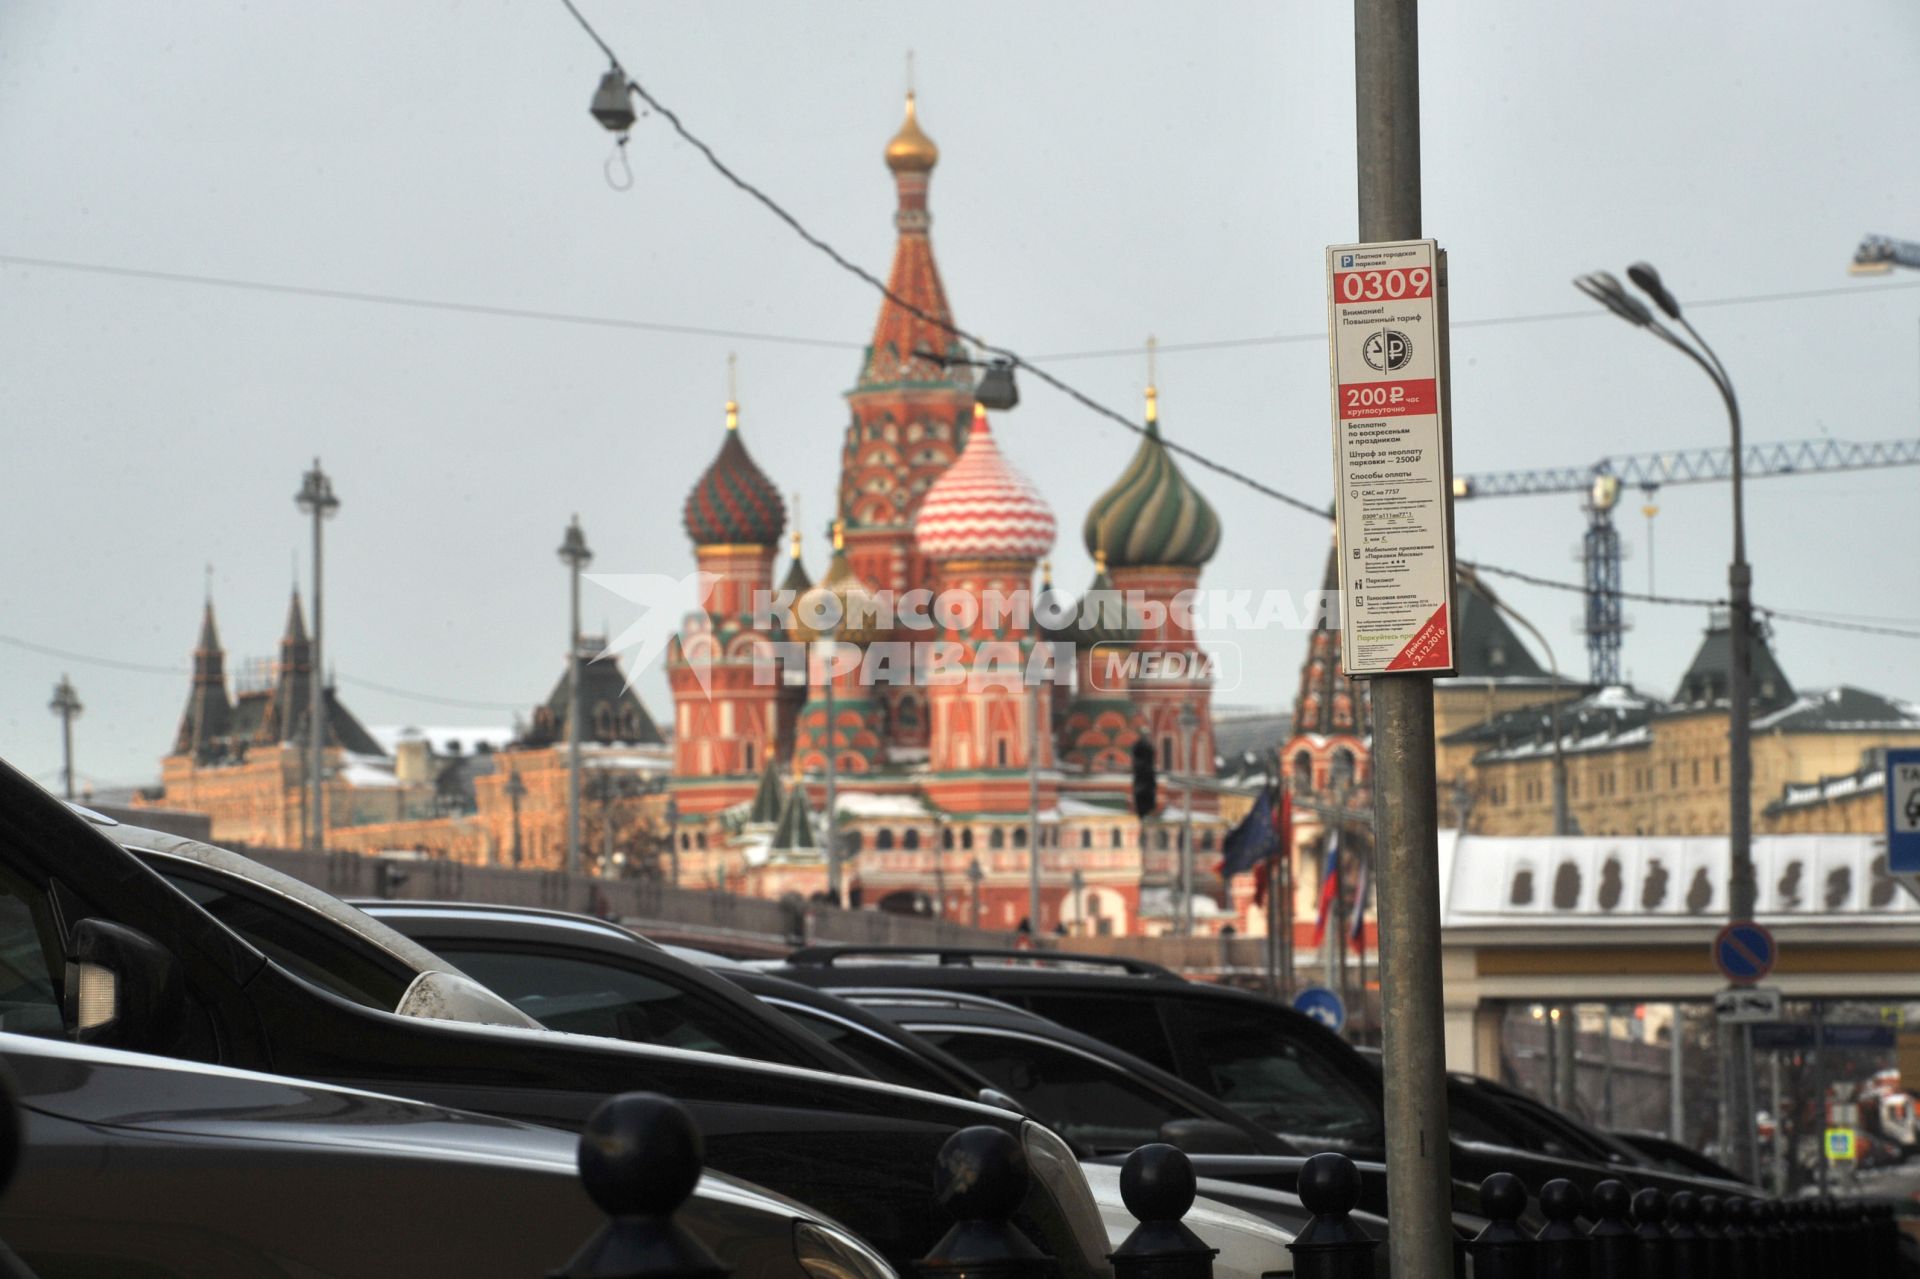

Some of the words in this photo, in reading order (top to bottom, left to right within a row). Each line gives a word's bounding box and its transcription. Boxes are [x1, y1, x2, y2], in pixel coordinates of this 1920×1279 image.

[1383, 250, 1417, 260] городская
[1355, 260, 1386, 268] парковка
[1343, 268, 1429, 300] 0309
[1342, 306, 1384, 317] Внимание!
[1343, 316, 1395, 326] Повышенный
[1396, 313, 1422, 323] тариф
[1347, 406, 1406, 416] круглосуточно
[1348, 422, 1387, 430] Бесплатно
[1359, 429, 1410, 438] воскресеньям
[1355, 436, 1401, 446] праздникам
[1349, 450, 1376, 459] Штраф
[1388, 448, 1423, 457] неоплату
[1349, 459, 1386, 468] парковки
[1350, 471, 1383, 480] Способы
[1384, 470, 1412, 479] оплаты
[1405, 624, 1435, 658] Действует
[1414, 628, 1446, 662] 2.12.2016
